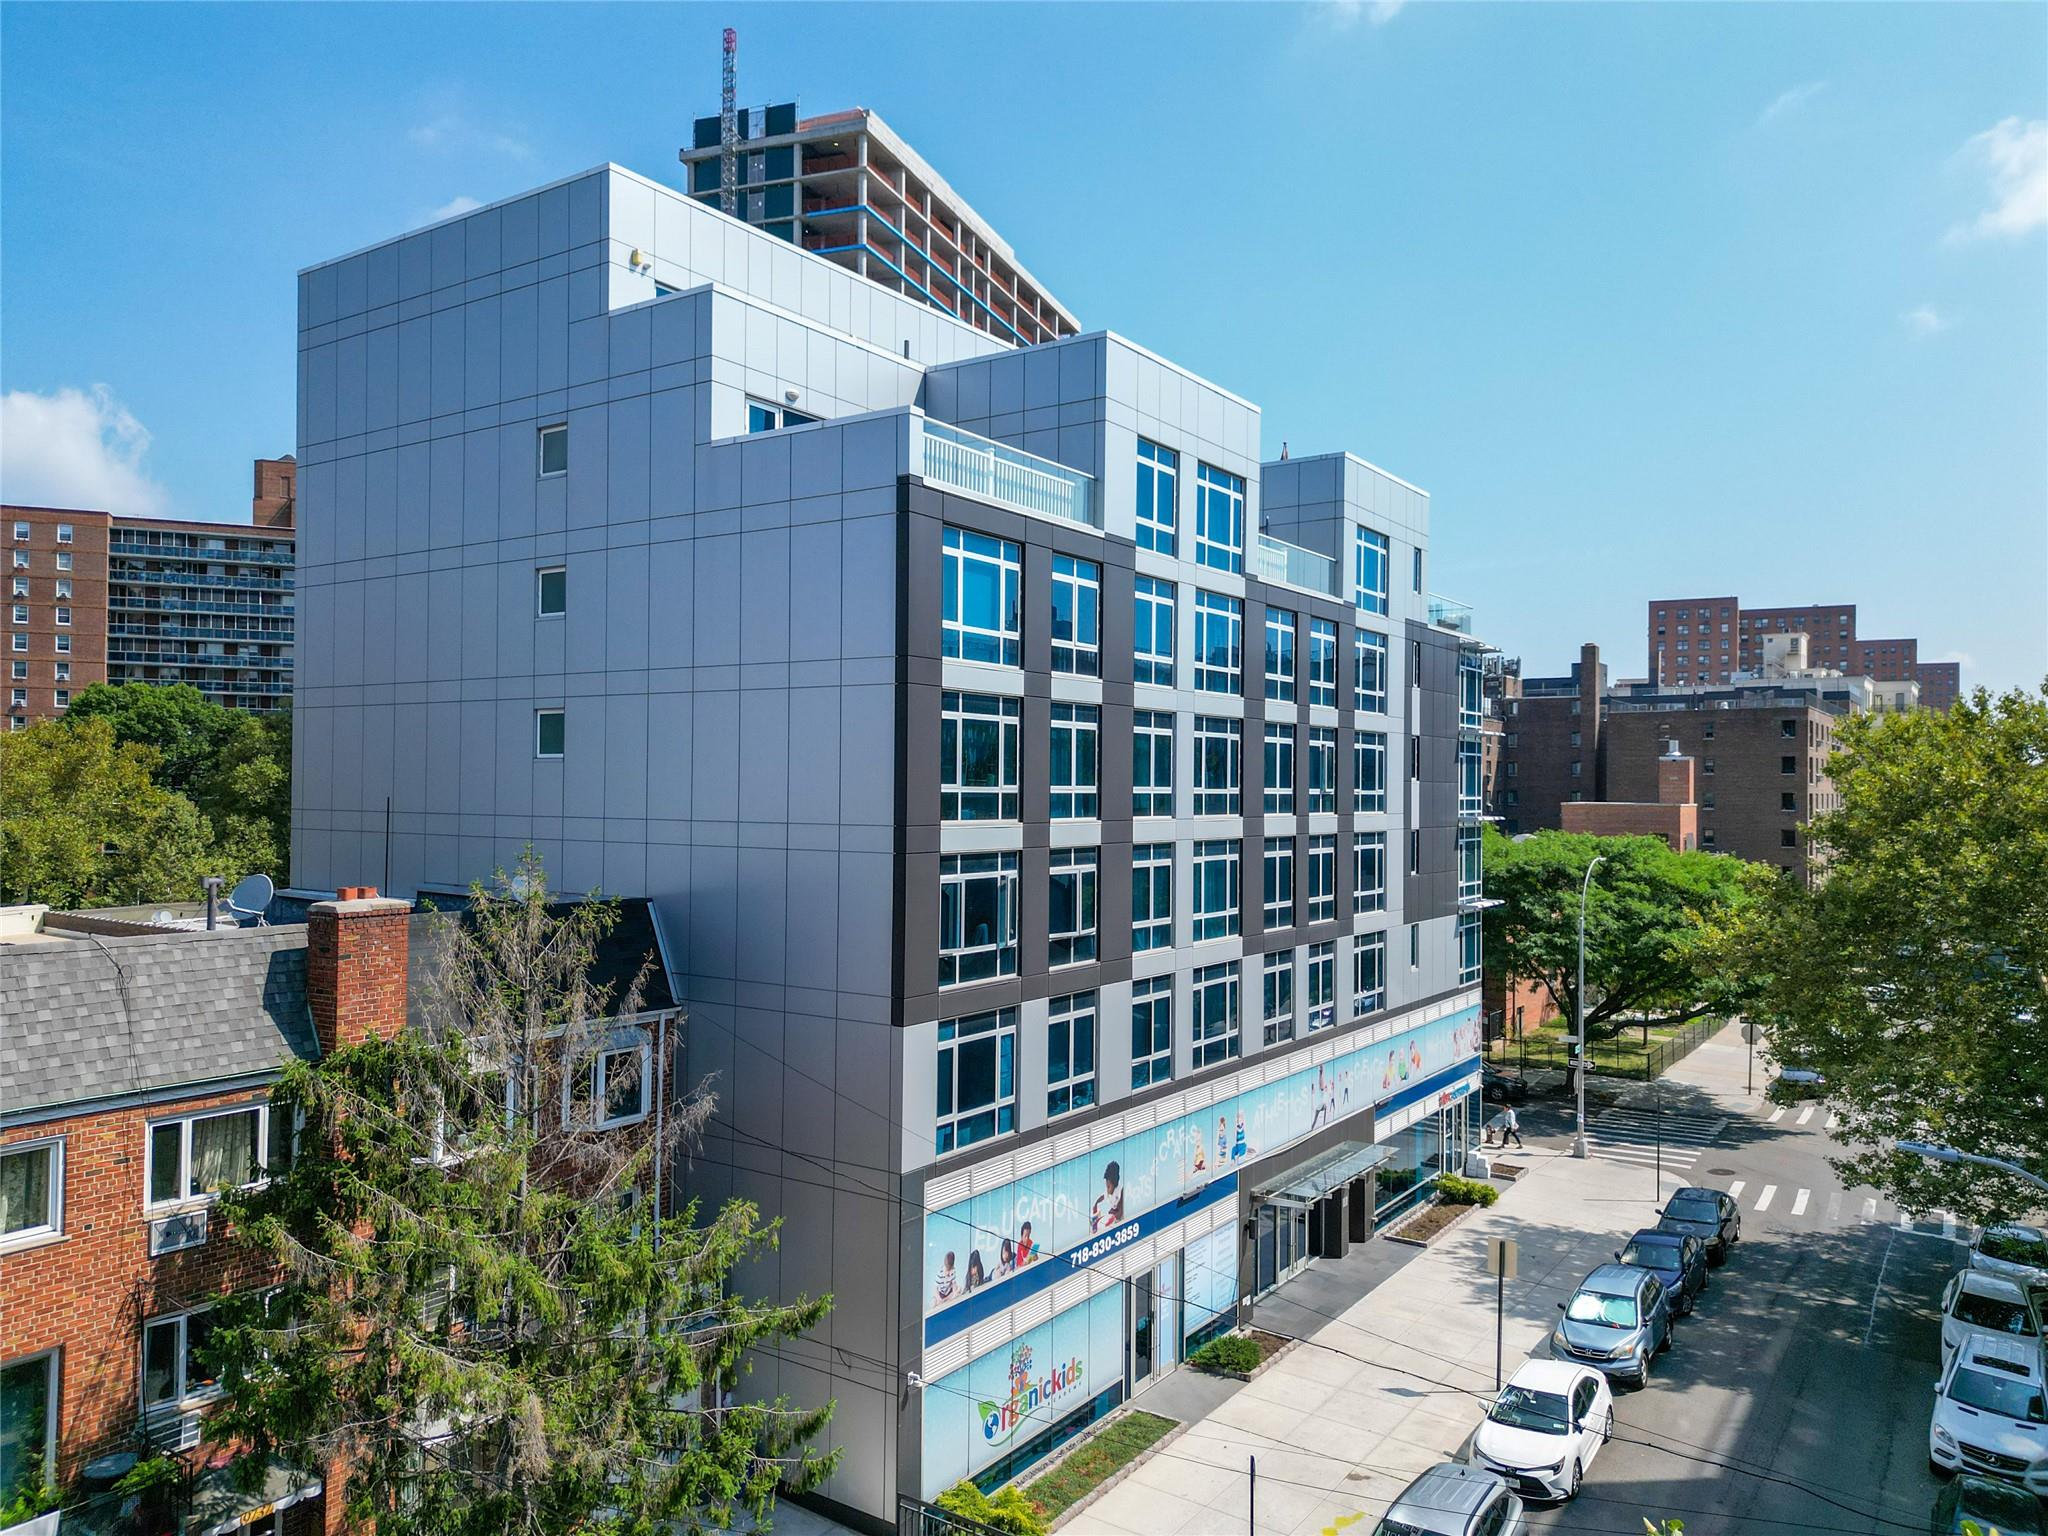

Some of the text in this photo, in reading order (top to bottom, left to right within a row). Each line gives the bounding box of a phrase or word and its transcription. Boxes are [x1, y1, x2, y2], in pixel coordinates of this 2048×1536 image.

[1159, 1125, 1199, 1161] CRAFTS
[975, 1193, 1079, 1252] EDUCATION
[1070, 1223, 1139, 1268] 718-830-3859
